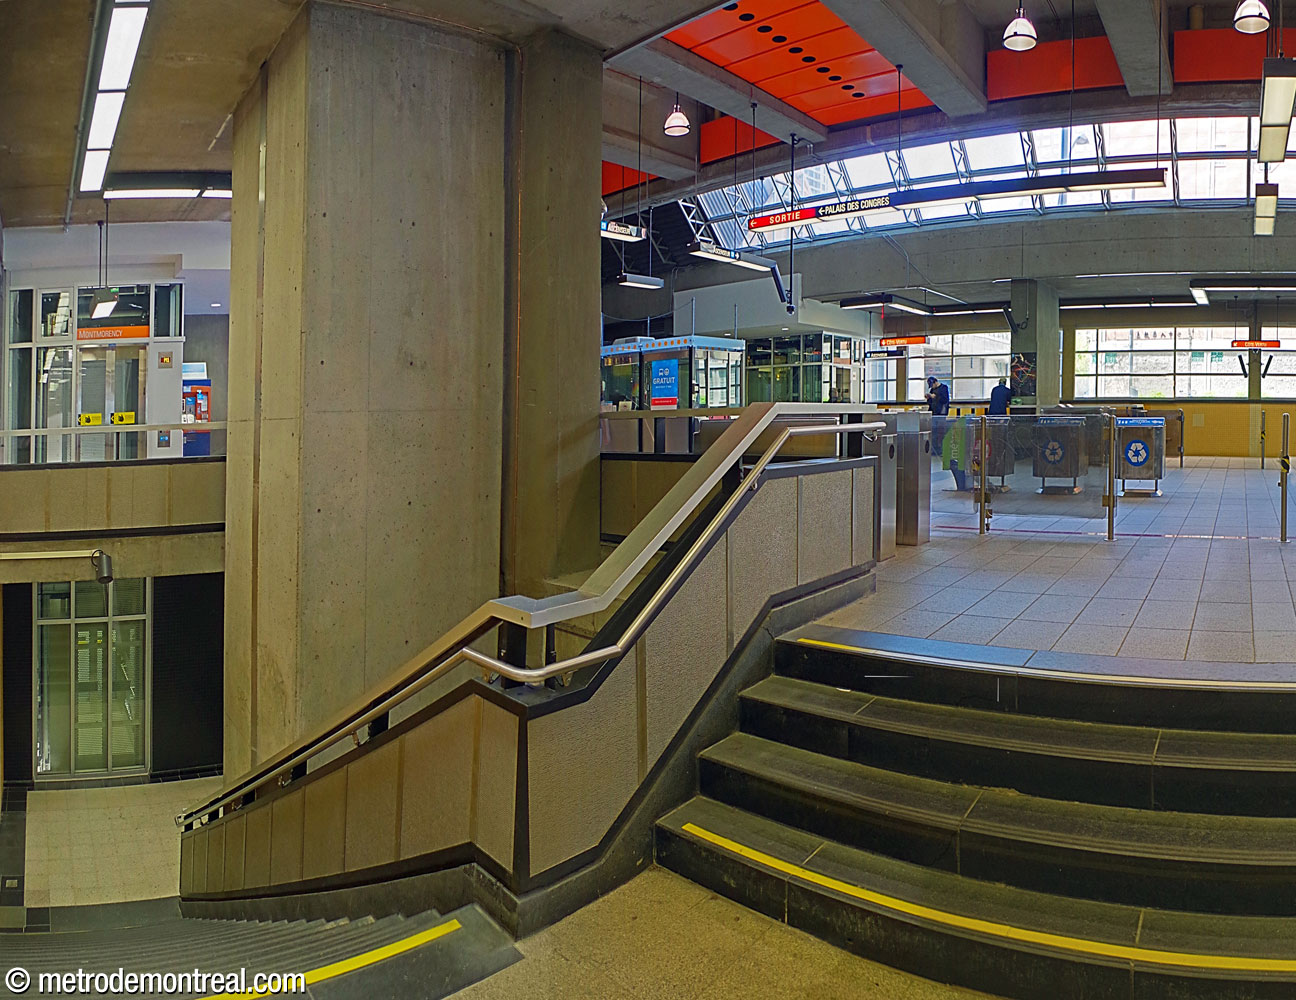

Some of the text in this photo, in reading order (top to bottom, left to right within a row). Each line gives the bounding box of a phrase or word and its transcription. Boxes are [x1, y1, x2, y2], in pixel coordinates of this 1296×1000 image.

[825, 202, 847, 214] PALAIS
[847, 201, 860, 210] DES
[769, 212, 801, 224] SORTIE
[79, 329, 122, 338] MONTMORENCY
[652, 376, 676, 385] GRATUIT
